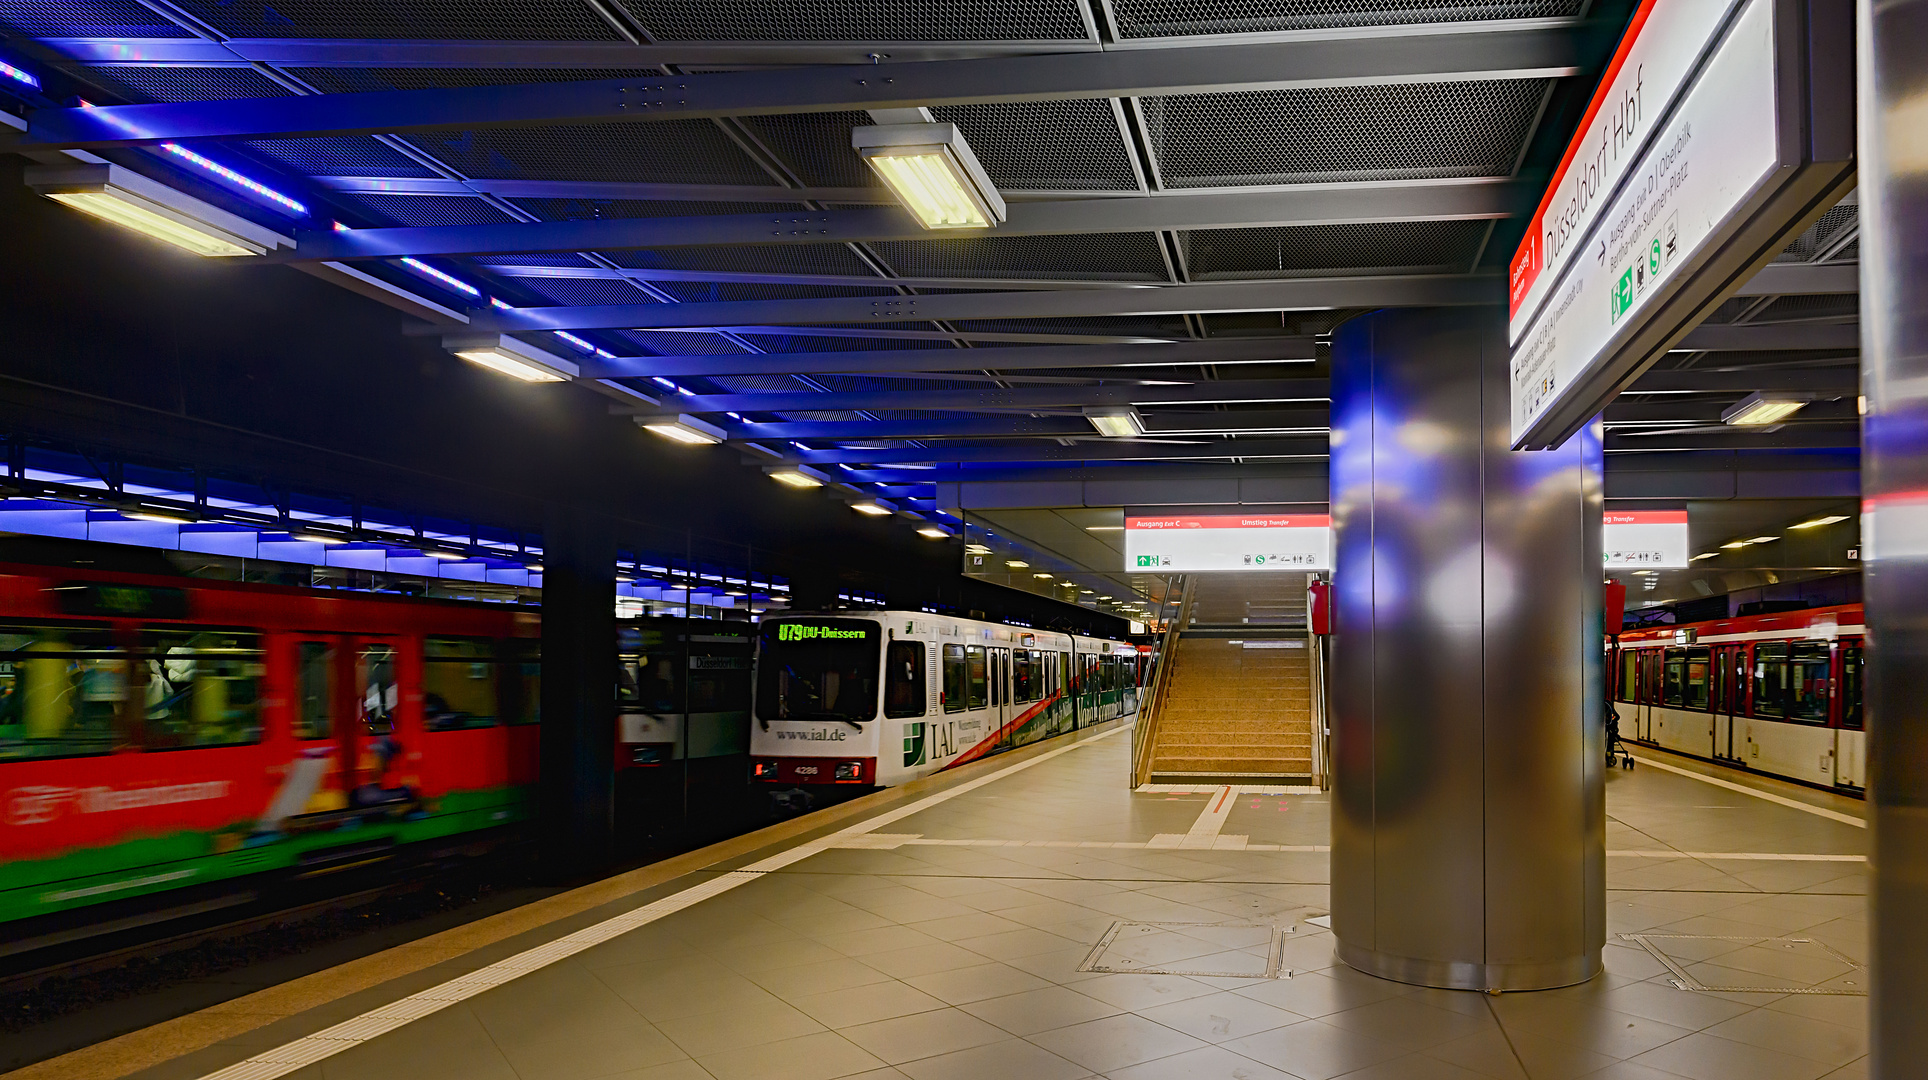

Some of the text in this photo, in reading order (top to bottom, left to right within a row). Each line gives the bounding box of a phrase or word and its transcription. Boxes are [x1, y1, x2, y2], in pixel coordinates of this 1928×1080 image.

[1546, 63, 1643, 271] Düsseldorf Hbf
[1609, 121, 1692, 248] Ausgang Exit D Oberbilk
[1609, 161, 1689, 273] Bertha-von-Suttner-Platz
[1530, 234, 1536, 271] 1
[1136, 520, 1164, 528] Ausgang
[1241, 518, 1268, 527] Umstieg
[778, 624, 803, 641] U79
[776, 728, 846, 742] www.ial.de
[931, 721, 959, 760] IAL
